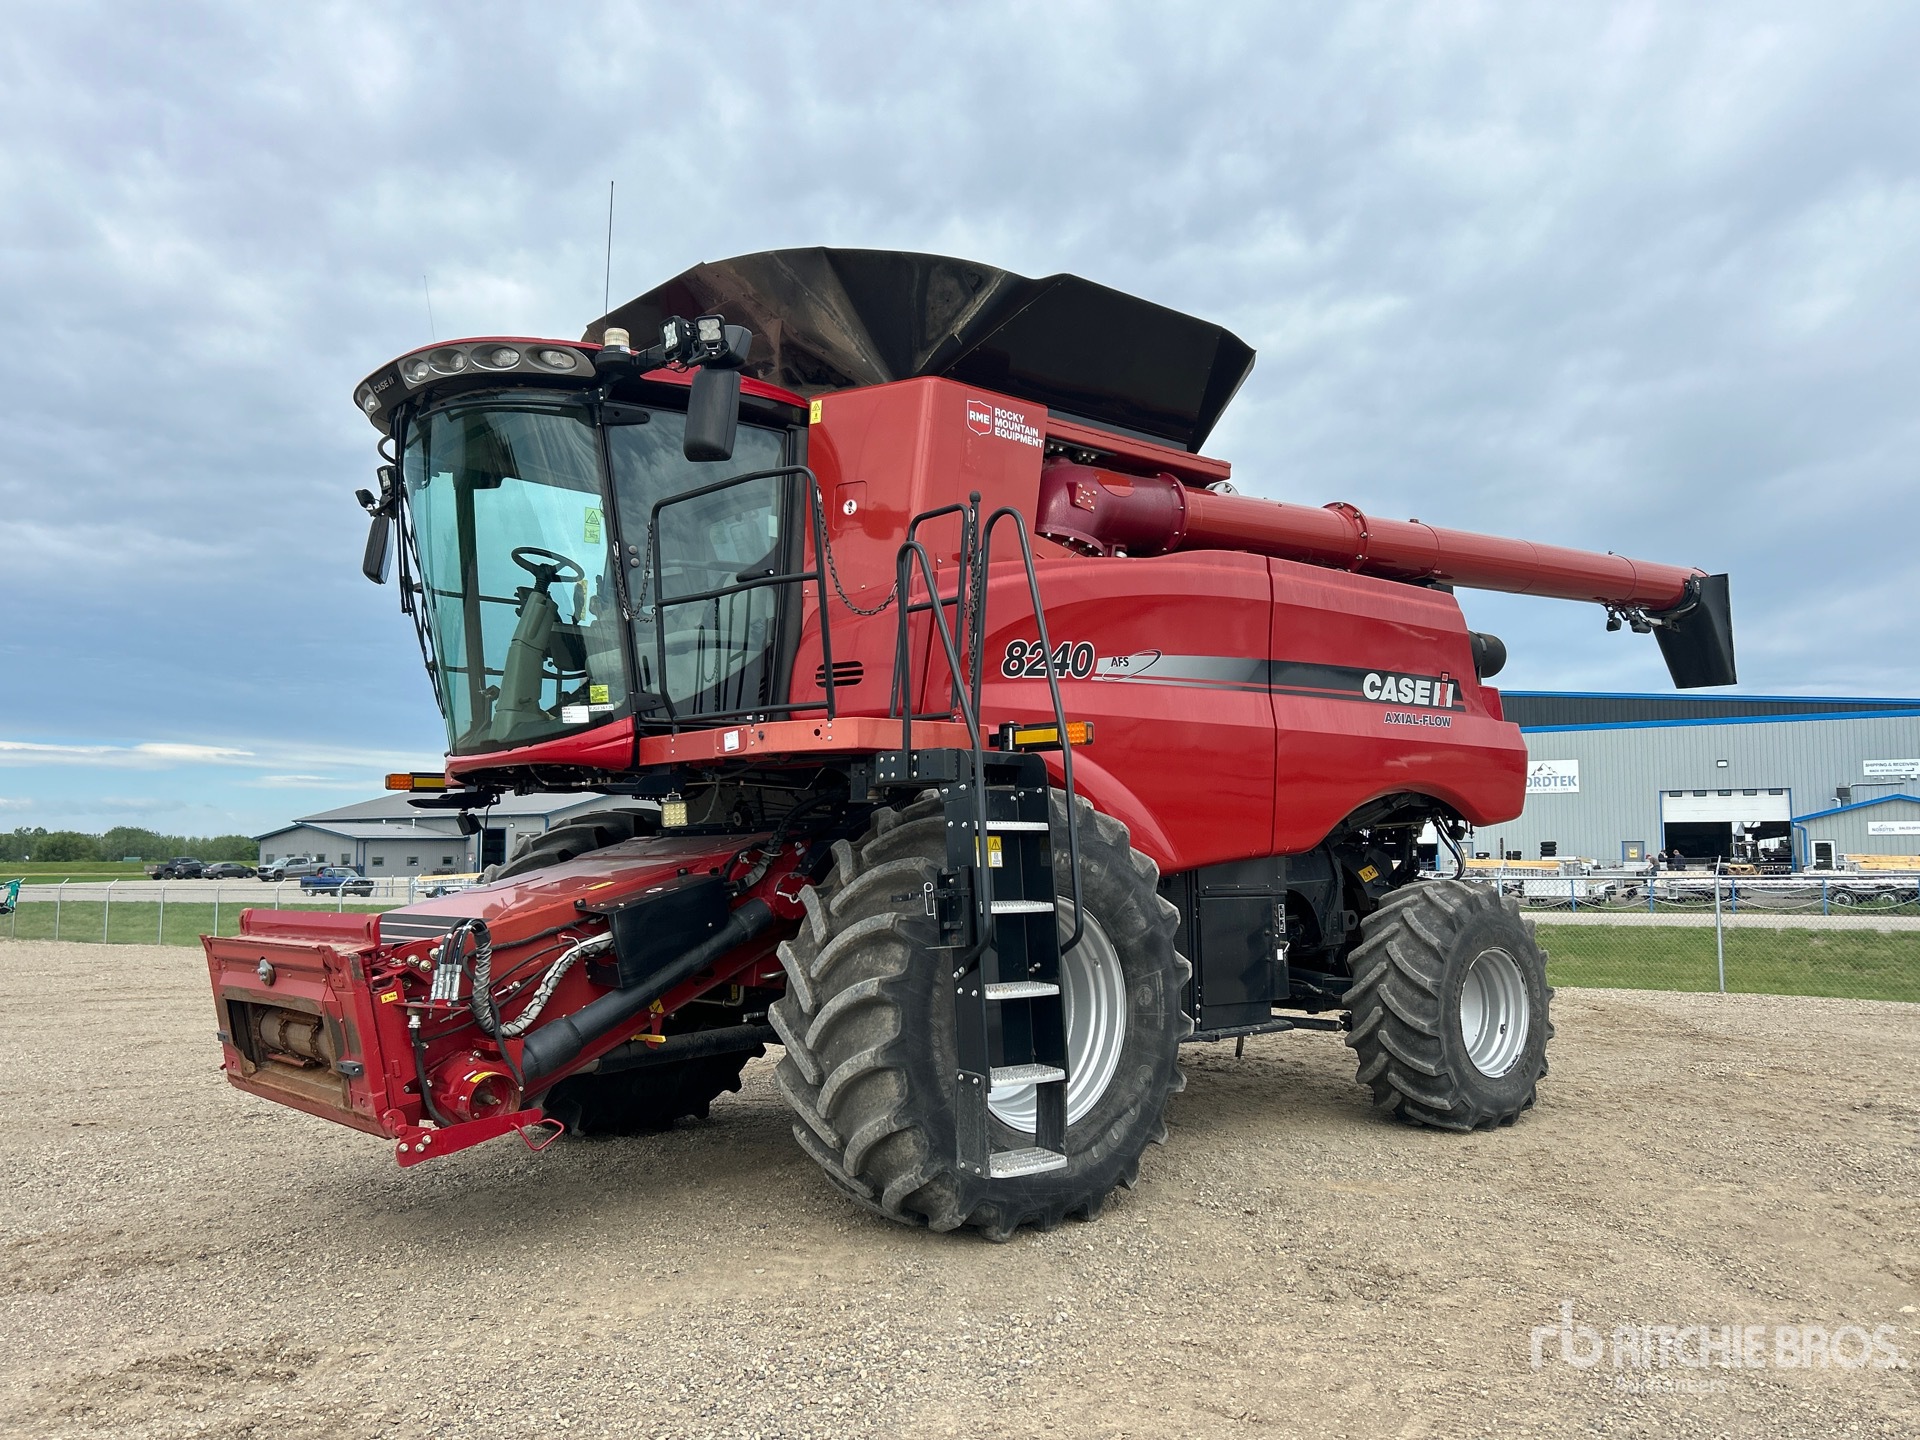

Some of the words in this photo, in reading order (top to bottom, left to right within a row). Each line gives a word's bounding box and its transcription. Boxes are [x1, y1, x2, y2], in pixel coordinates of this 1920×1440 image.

[969, 410, 990, 425] RME
[994, 407, 1025, 423] ROCKY
[994, 417, 1039, 437] MOUNTAIN
[994, 427, 1043, 448] EQUIPMENT
[1001, 639, 1095, 680] 8240
[1110, 656, 1130, 668] AFS
[1384, 711, 1452, 728] AXIAL-FLOW
[1526, 775, 1577, 788] ORDTEK
